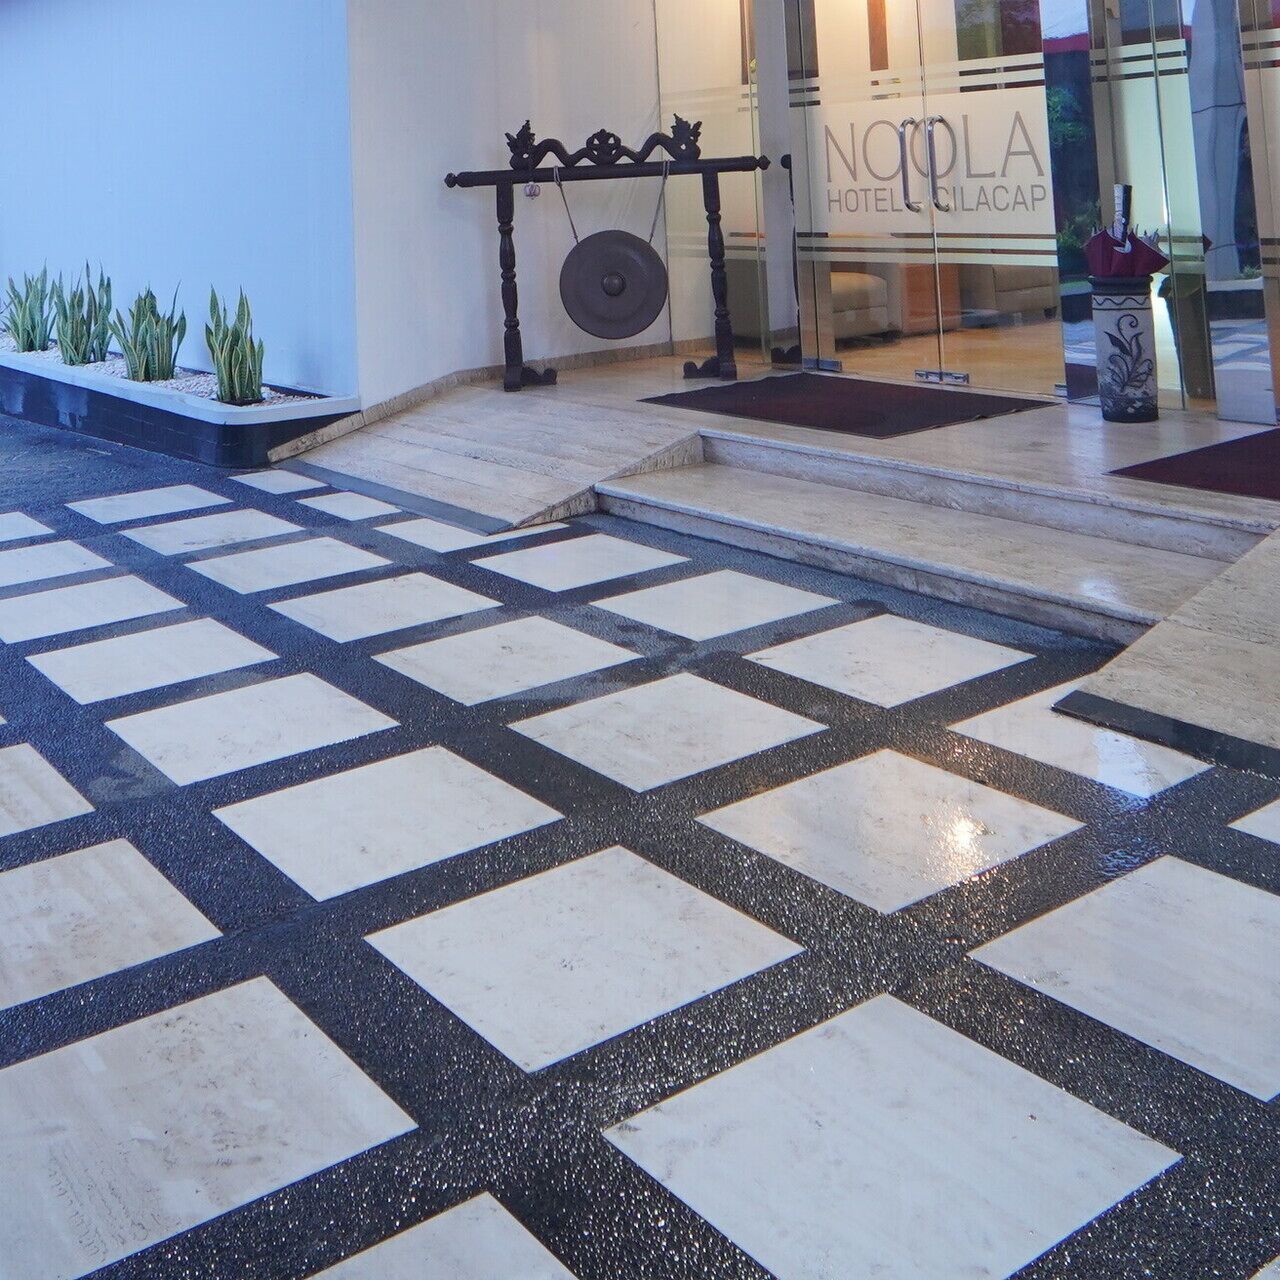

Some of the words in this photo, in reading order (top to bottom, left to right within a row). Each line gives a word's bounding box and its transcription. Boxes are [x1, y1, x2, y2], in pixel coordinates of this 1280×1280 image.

[824, 110, 1045, 183] NOOLA
[827, 187, 903, 213] HOTEL
[936, 184, 1047, 213] CILACAP
